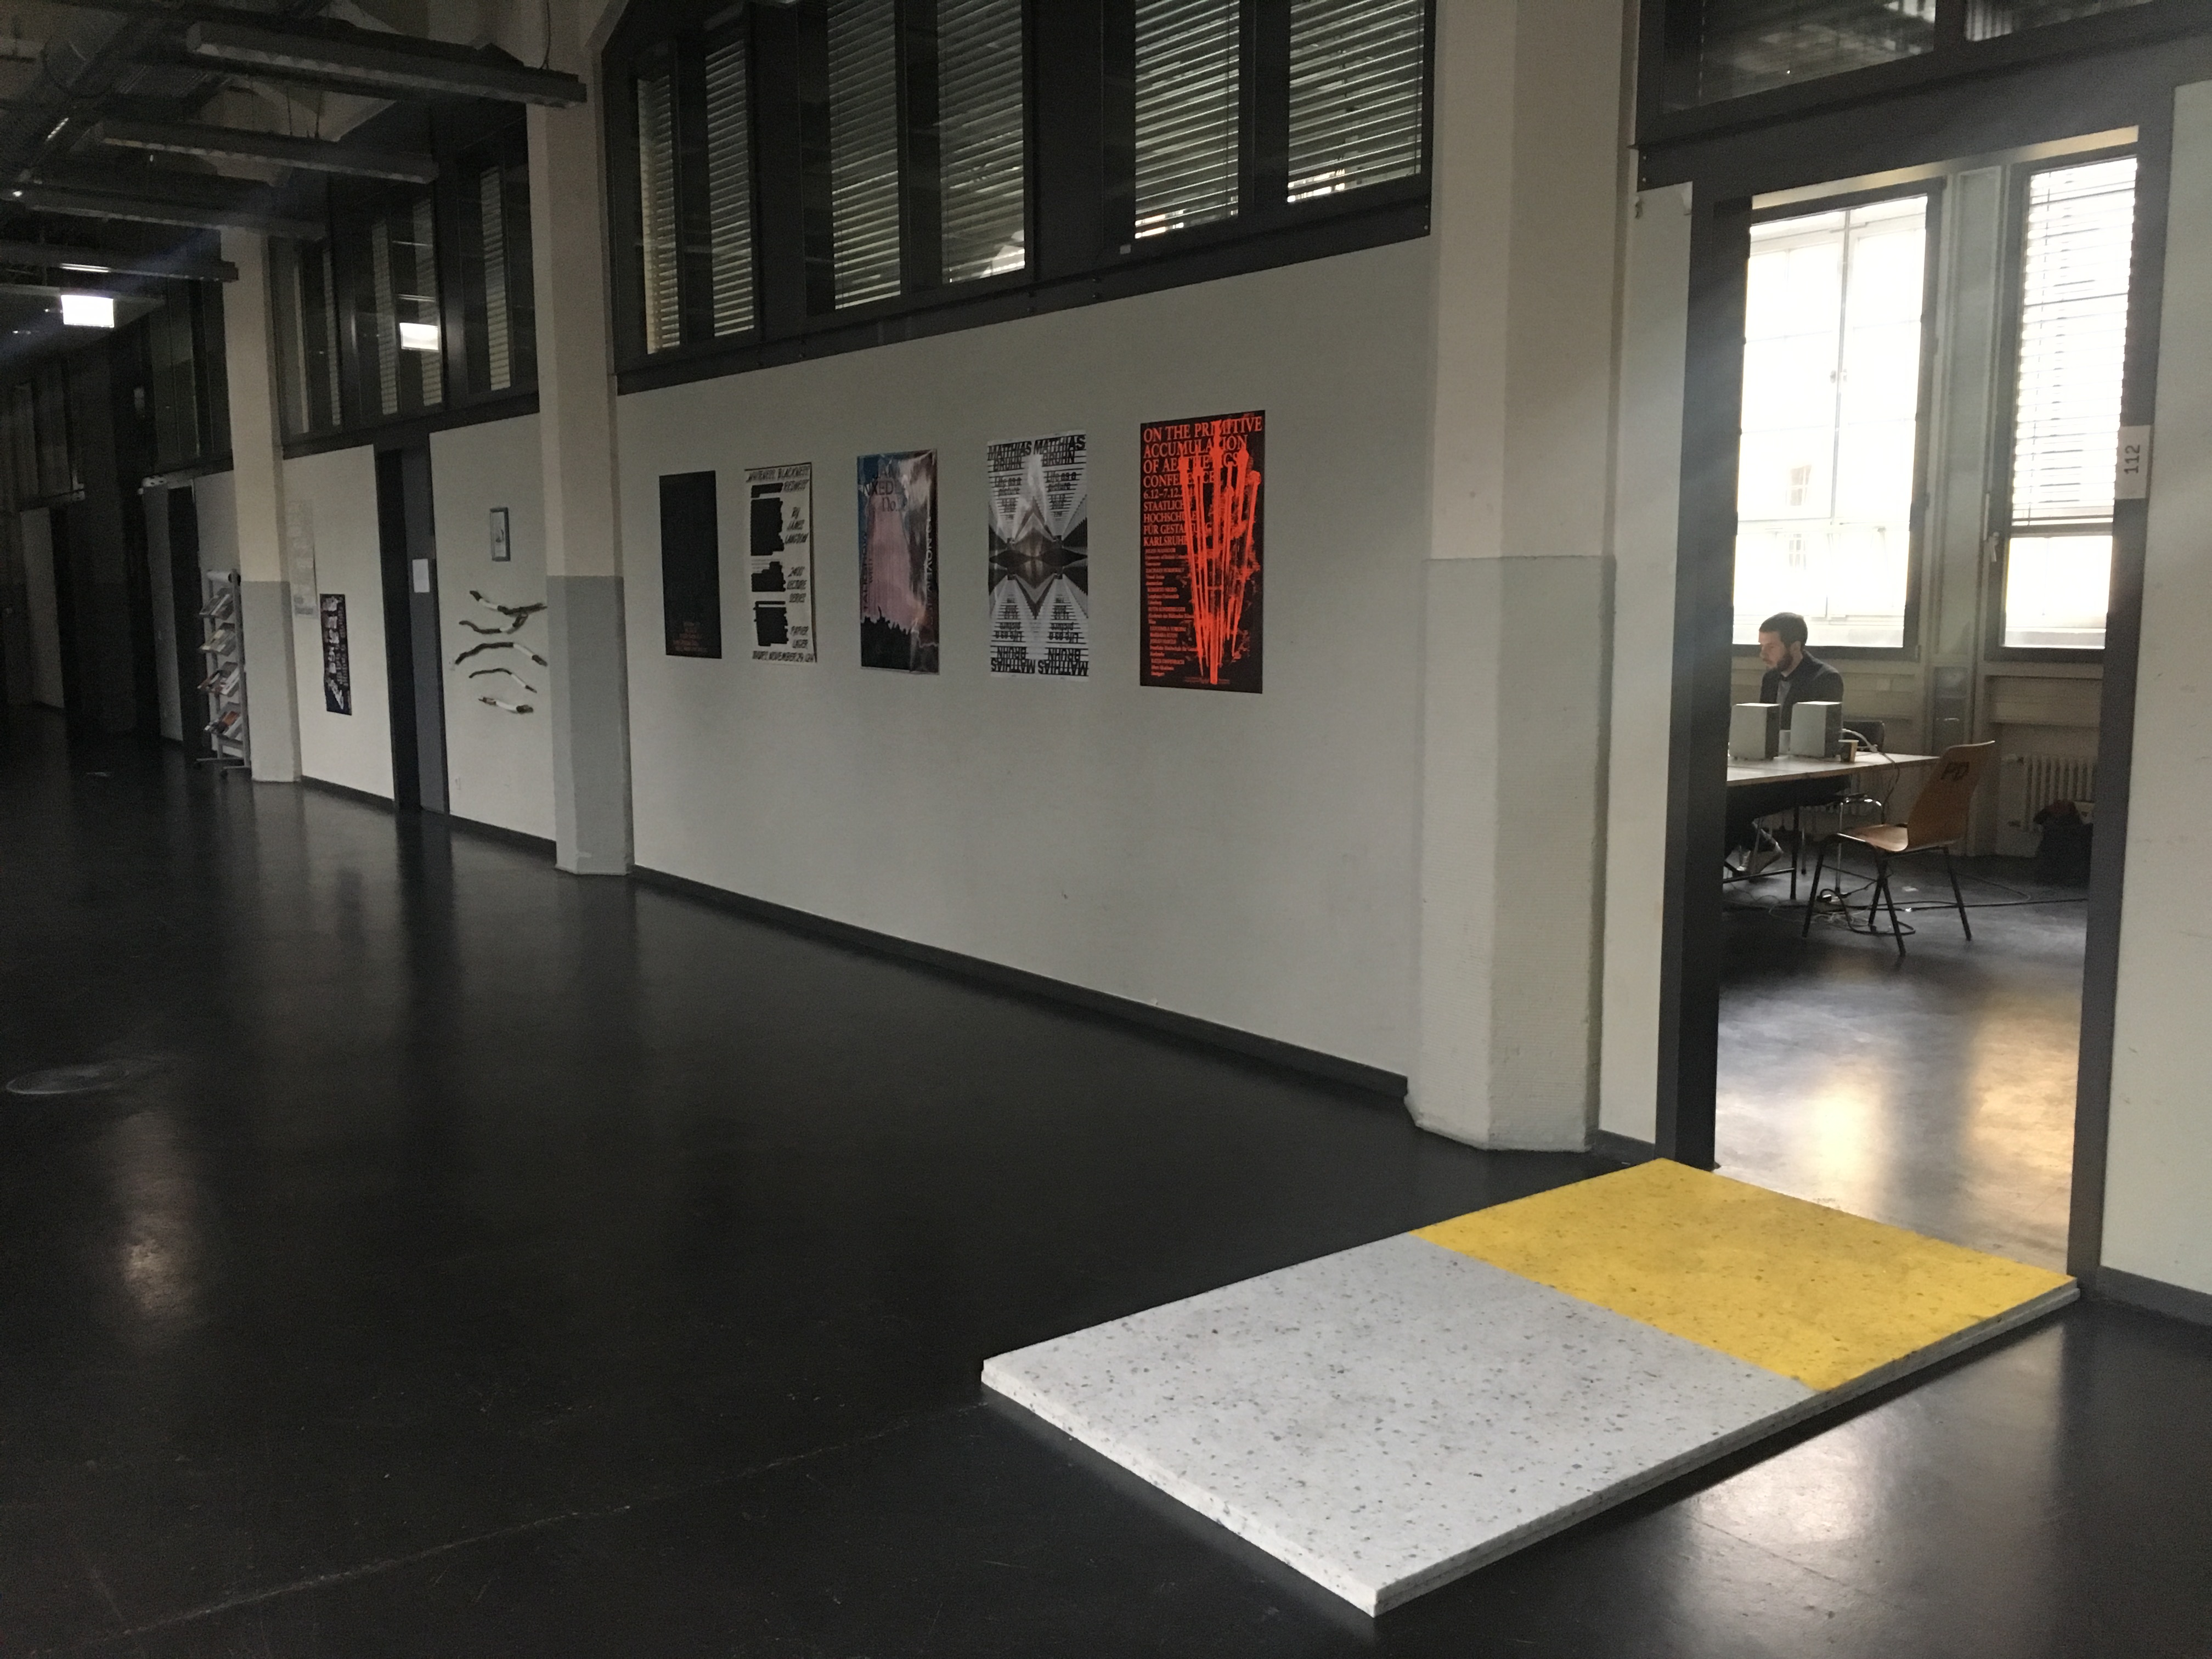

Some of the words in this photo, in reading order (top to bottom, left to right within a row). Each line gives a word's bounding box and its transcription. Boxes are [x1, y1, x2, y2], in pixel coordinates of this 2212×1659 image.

[1143, 427, 1162, 442] ON
[1165, 424, 1190, 441] THE
[1034, 435, 1086, 455] MATTHIAS
[1143, 434, 1248, 459] ACCUMULAION
[1042, 450, 1075, 467] BRUHN
[1143, 459, 1159, 474] OF
[2124, 445, 2141, 475] 112
[1143, 499, 1192, 512] STAATLICH
[1143, 511, 1198, 523] HOCHSCHUE
[1143, 523, 1159, 535] FÜR
[997, 646, 1026, 659] BRUHN
[1048, 648, 1081, 661] BRUHN
[990, 658, 1036, 674] MATTHIAS
[1037, 659, 1088, 676] MATTHIAS
